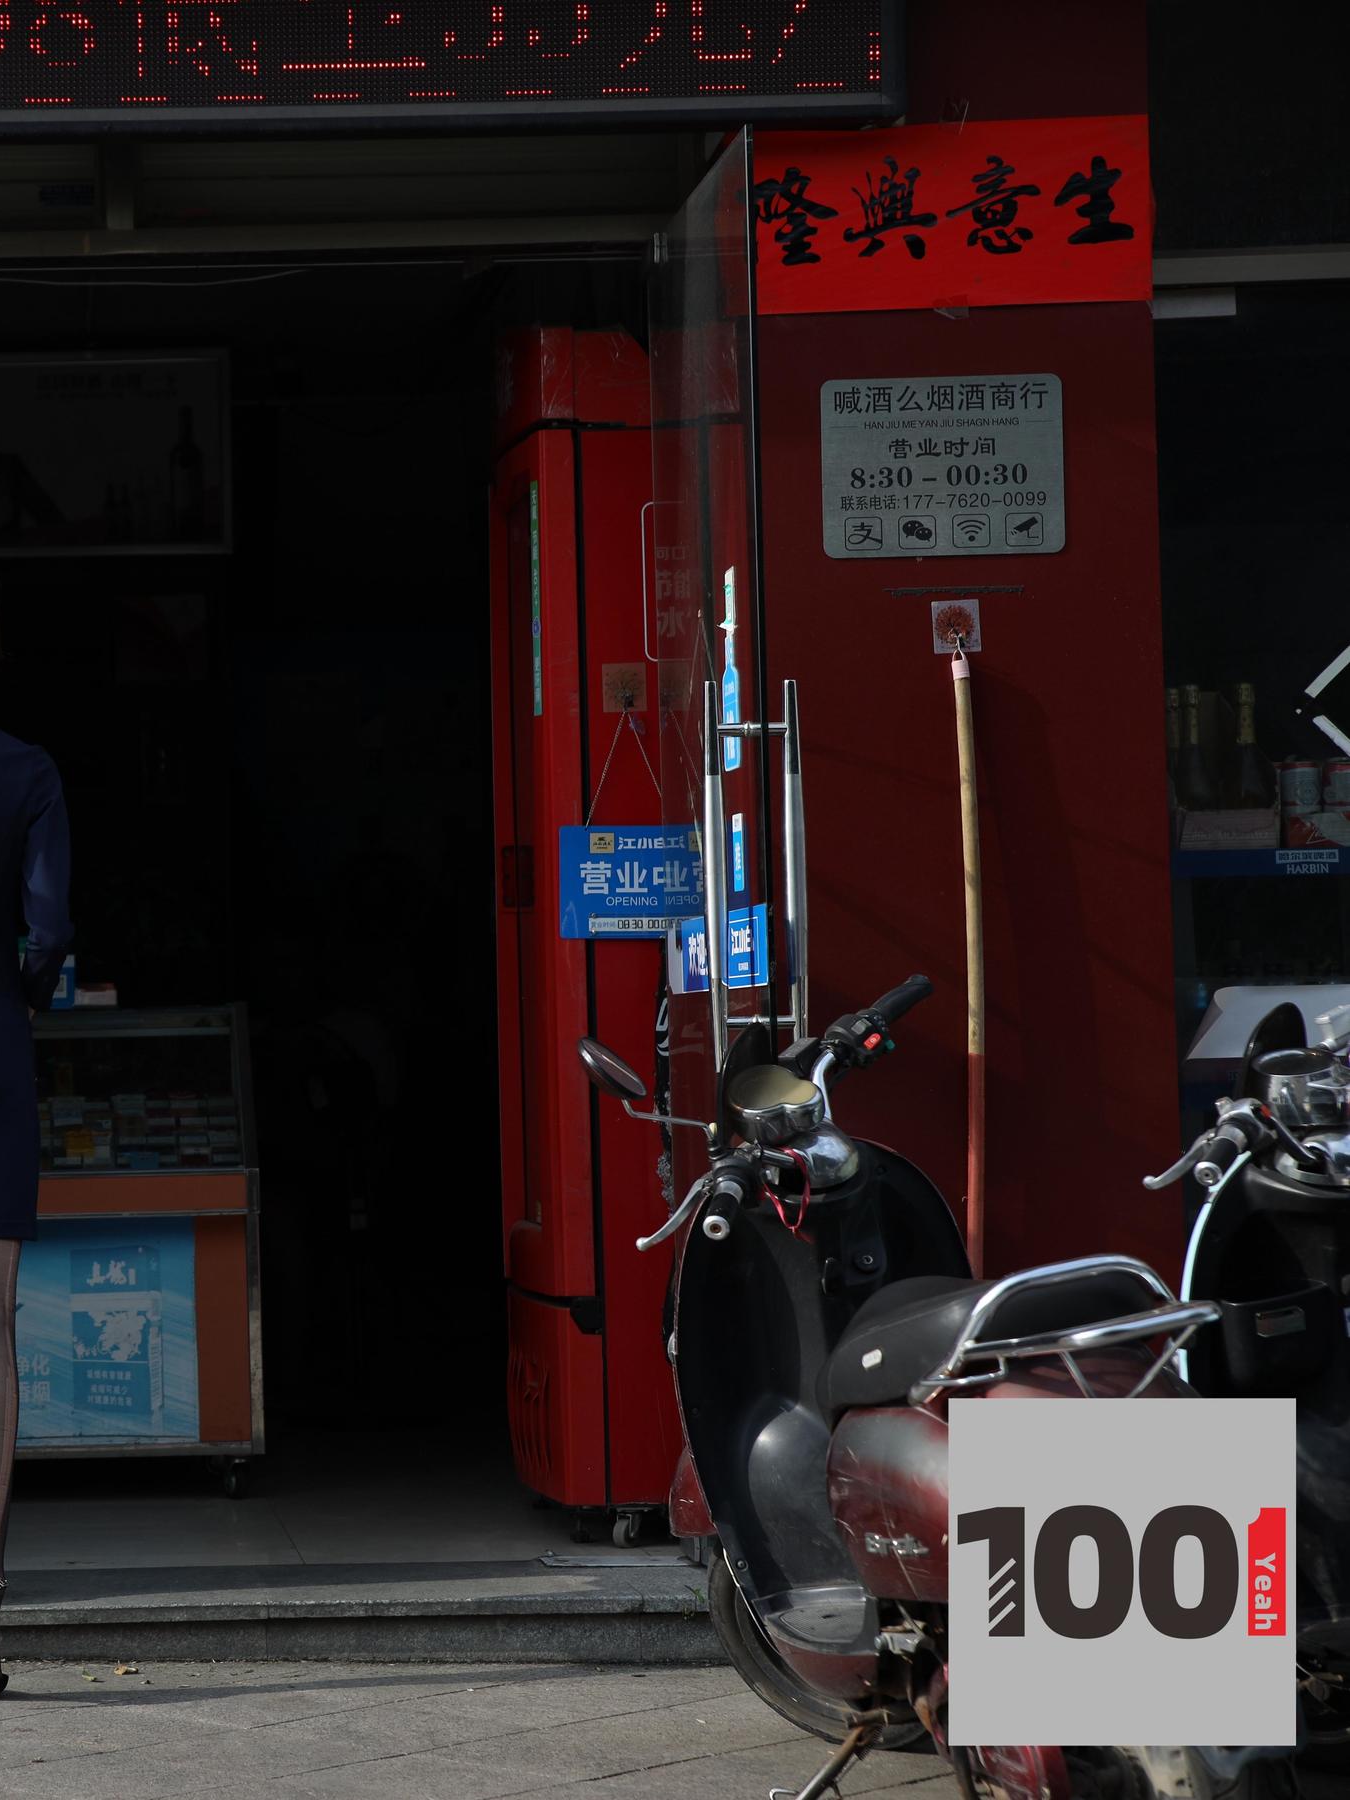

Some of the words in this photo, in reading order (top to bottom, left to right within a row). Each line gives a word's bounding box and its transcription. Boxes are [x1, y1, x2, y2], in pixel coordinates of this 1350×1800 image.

[833, 380, 1049, 415] 喊酒么烟酒商行
[863, 420, 884, 430] HAN
[885, 420, 900, 430] JIU
[902, 419, 918, 429] ME
[919, 419, 939, 429] YAN
[940, 418, 955, 428] JIU
[992, 416, 1020, 427] HANG
[888, 436, 996, 460] 营业时间
[1286, 863, 1330, 875] HARBIN
[605, 896, 658, 907] OPENING
